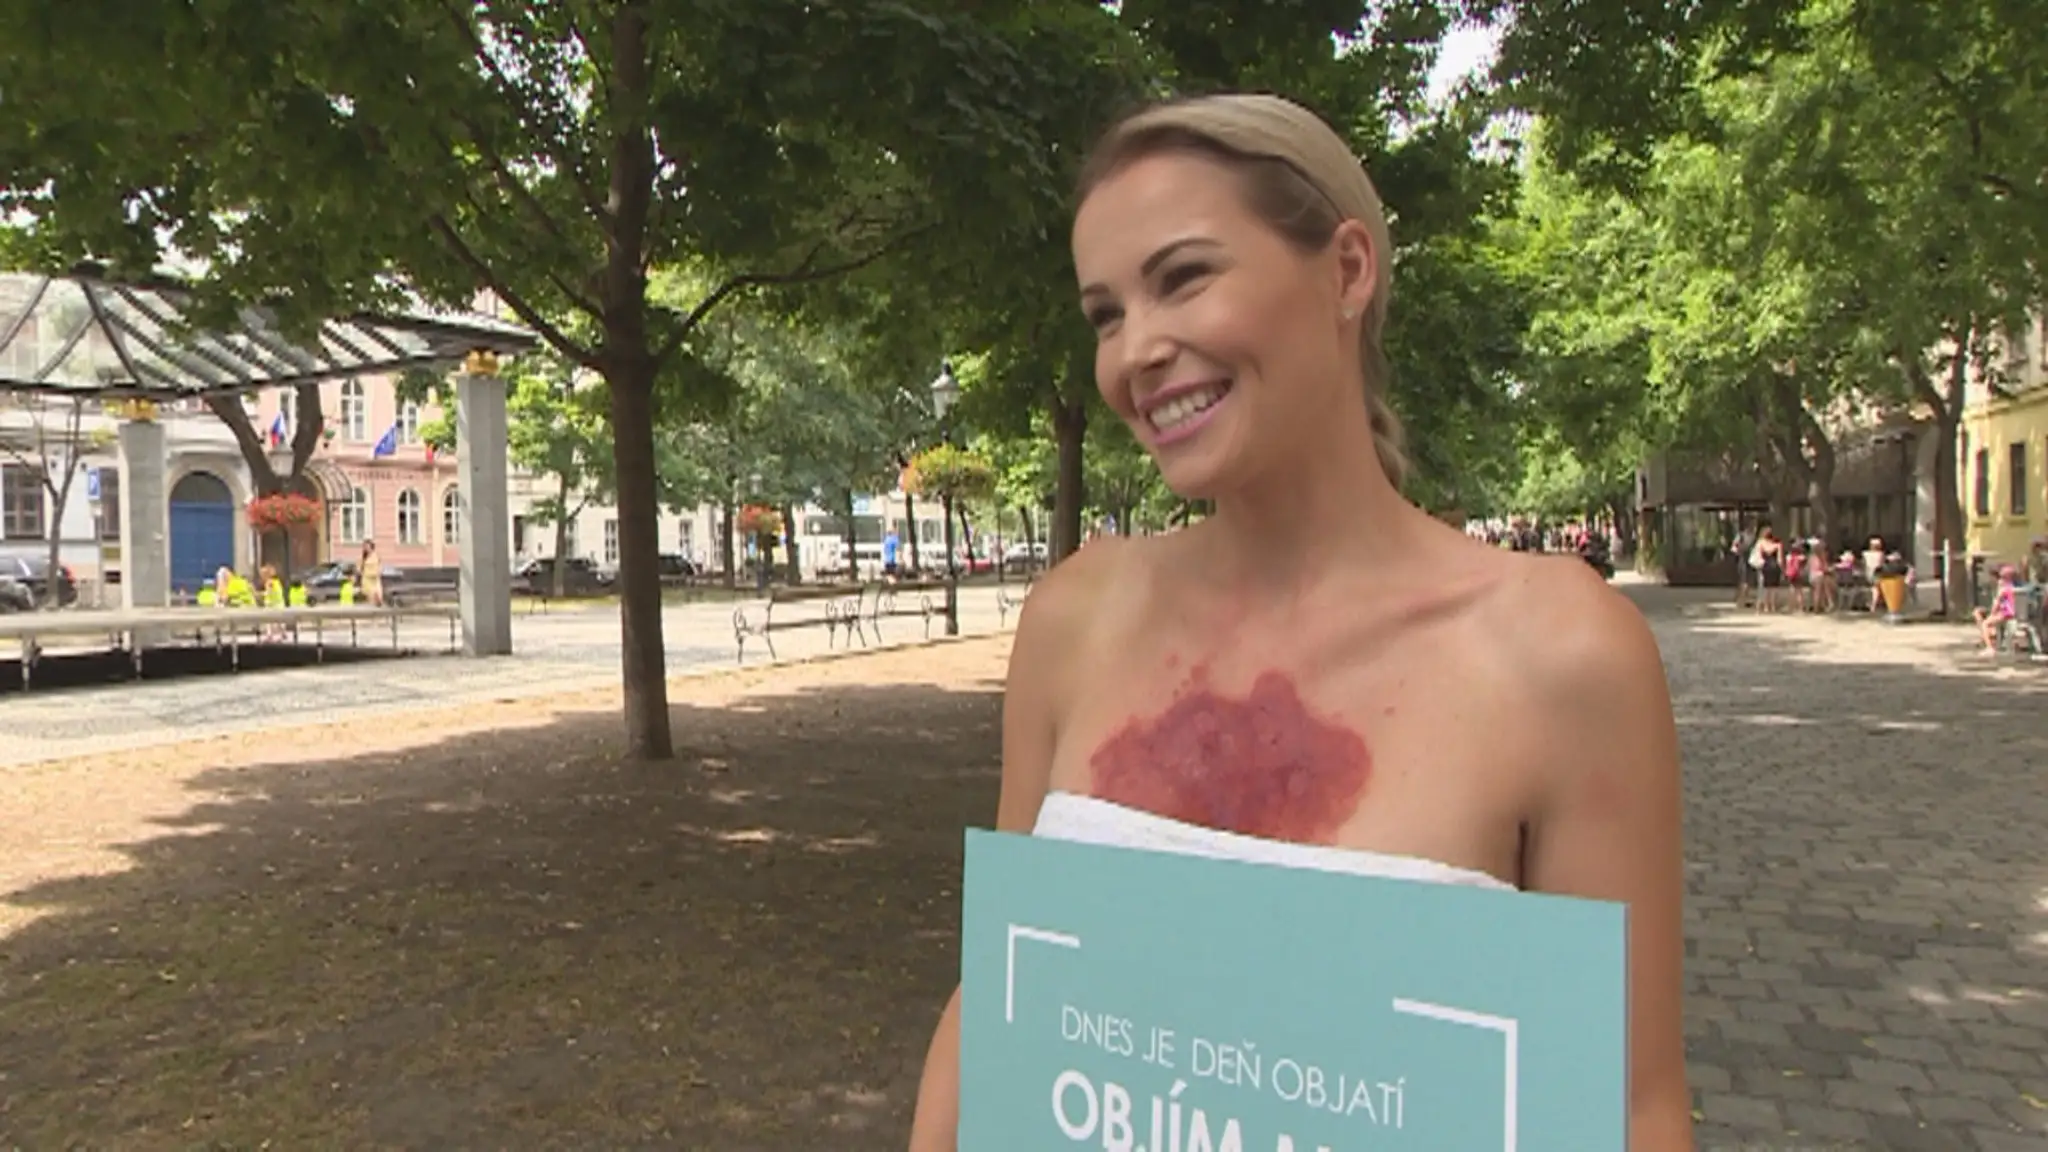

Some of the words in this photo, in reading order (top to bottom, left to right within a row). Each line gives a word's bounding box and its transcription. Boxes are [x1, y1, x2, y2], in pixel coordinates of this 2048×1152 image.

[1061, 1003, 1134, 1058] DNES
[1142, 1026, 1175, 1068] JE
[1192, 1037, 1261, 1090] DEŇ
[1272, 1058, 1406, 1129] OBJATÍ
